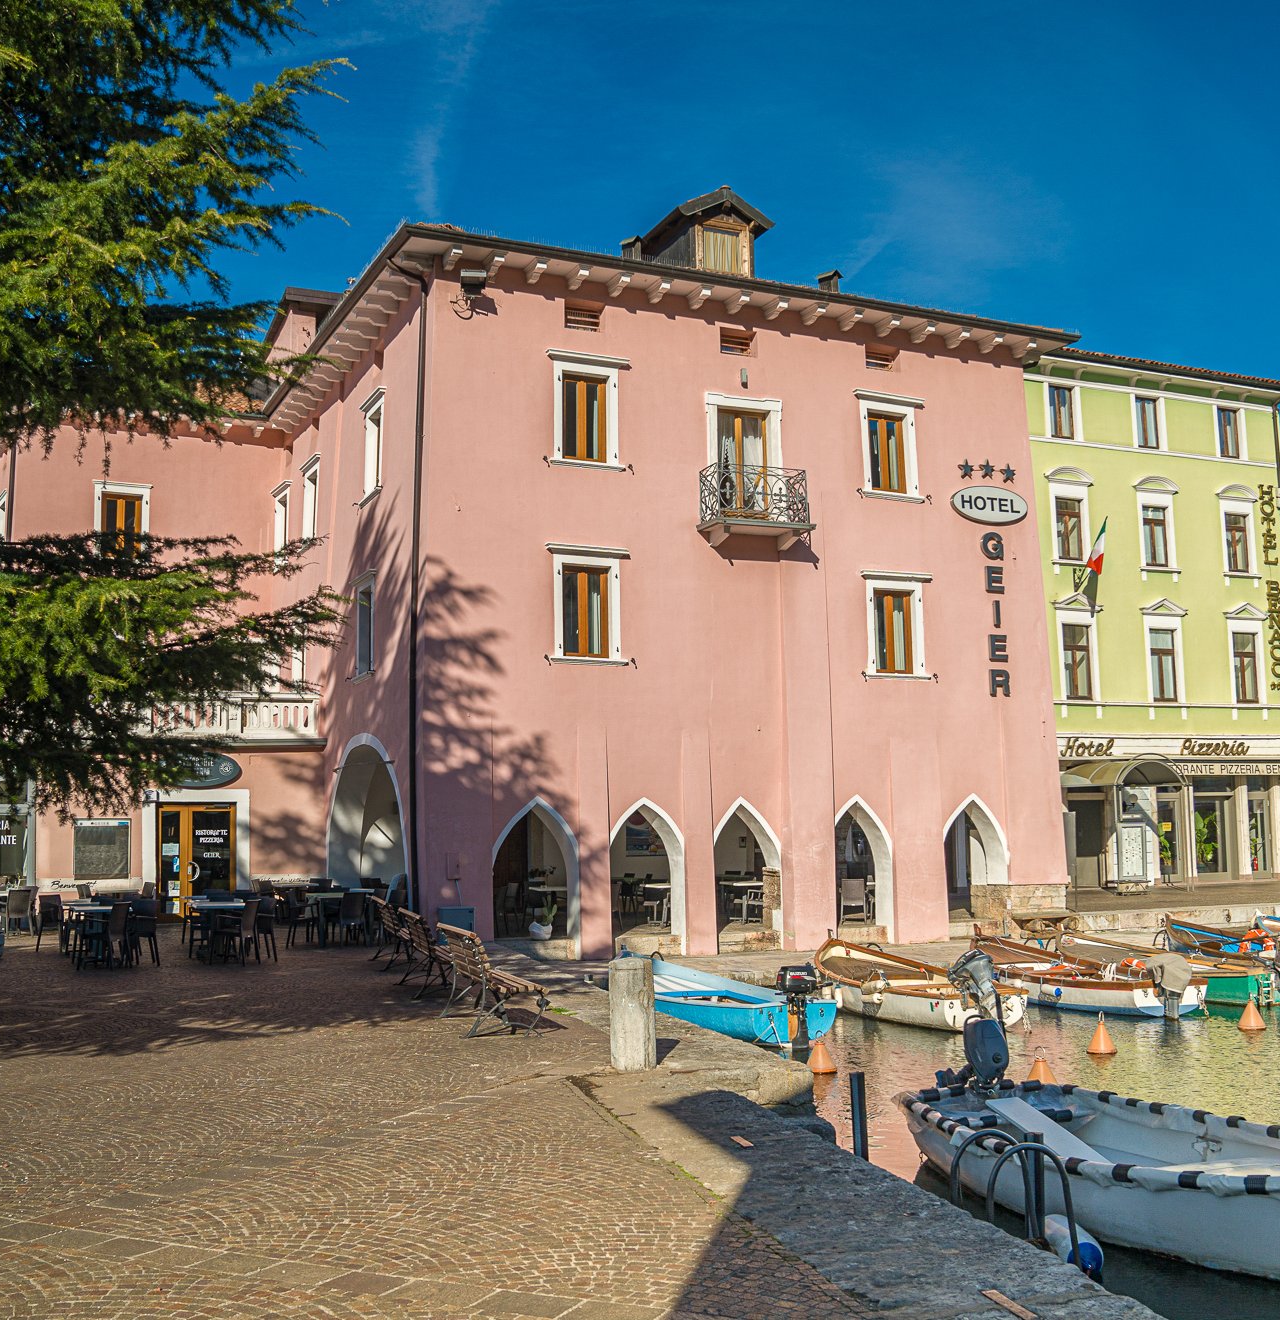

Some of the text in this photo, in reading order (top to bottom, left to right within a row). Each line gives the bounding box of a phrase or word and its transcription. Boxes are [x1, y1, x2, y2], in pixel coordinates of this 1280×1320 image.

[960, 494, 1021, 514] HOTEL
[1257, 483, 1279, 566] HOTEL
[980, 531, 1012, 698] GEIER
[1059, 737, 1115, 757] Hotel
[1179, 737, 1250, 757] Pizzeria
[1220, 764, 1261, 775] PIZZERIA
[203, 851, 222, 859] GEIER
